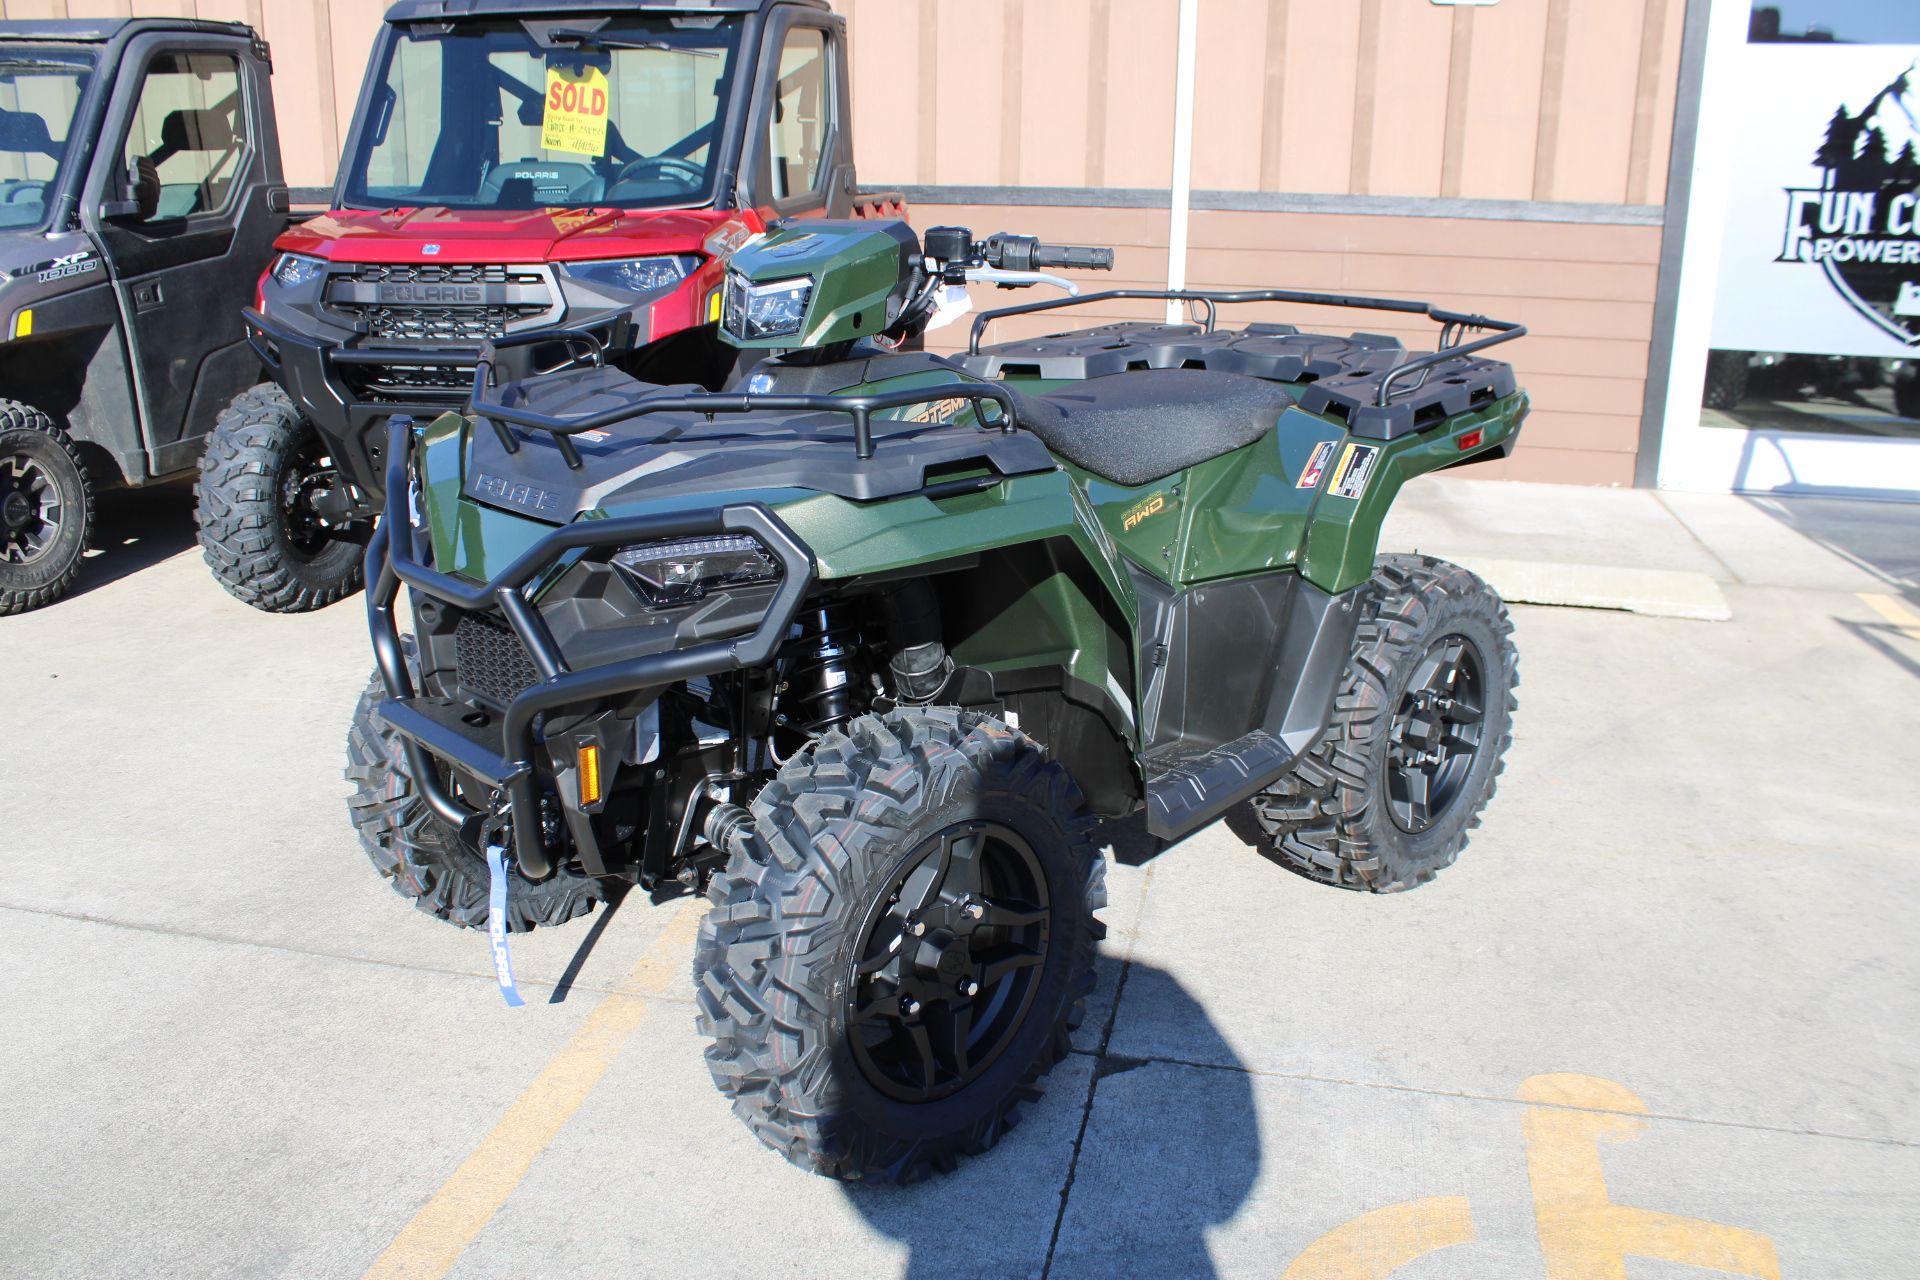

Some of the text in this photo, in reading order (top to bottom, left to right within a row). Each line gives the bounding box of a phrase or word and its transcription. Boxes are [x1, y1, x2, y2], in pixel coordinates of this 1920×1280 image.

[550, 81, 606, 116] SOLD
[515, 171, 559, 179] POLARIS
[1779, 189, 1876, 263] FUN
[51, 251, 89, 268] XP
[1814, 237, 1920, 264] POWER
[39, 260, 97, 283] 1000
[381, 286, 481, 301] POLARIS
[475, 473, 560, 510] POLARIS
[1124, 497, 1163, 531] AWD
[491, 907, 513, 988] POLARIS
